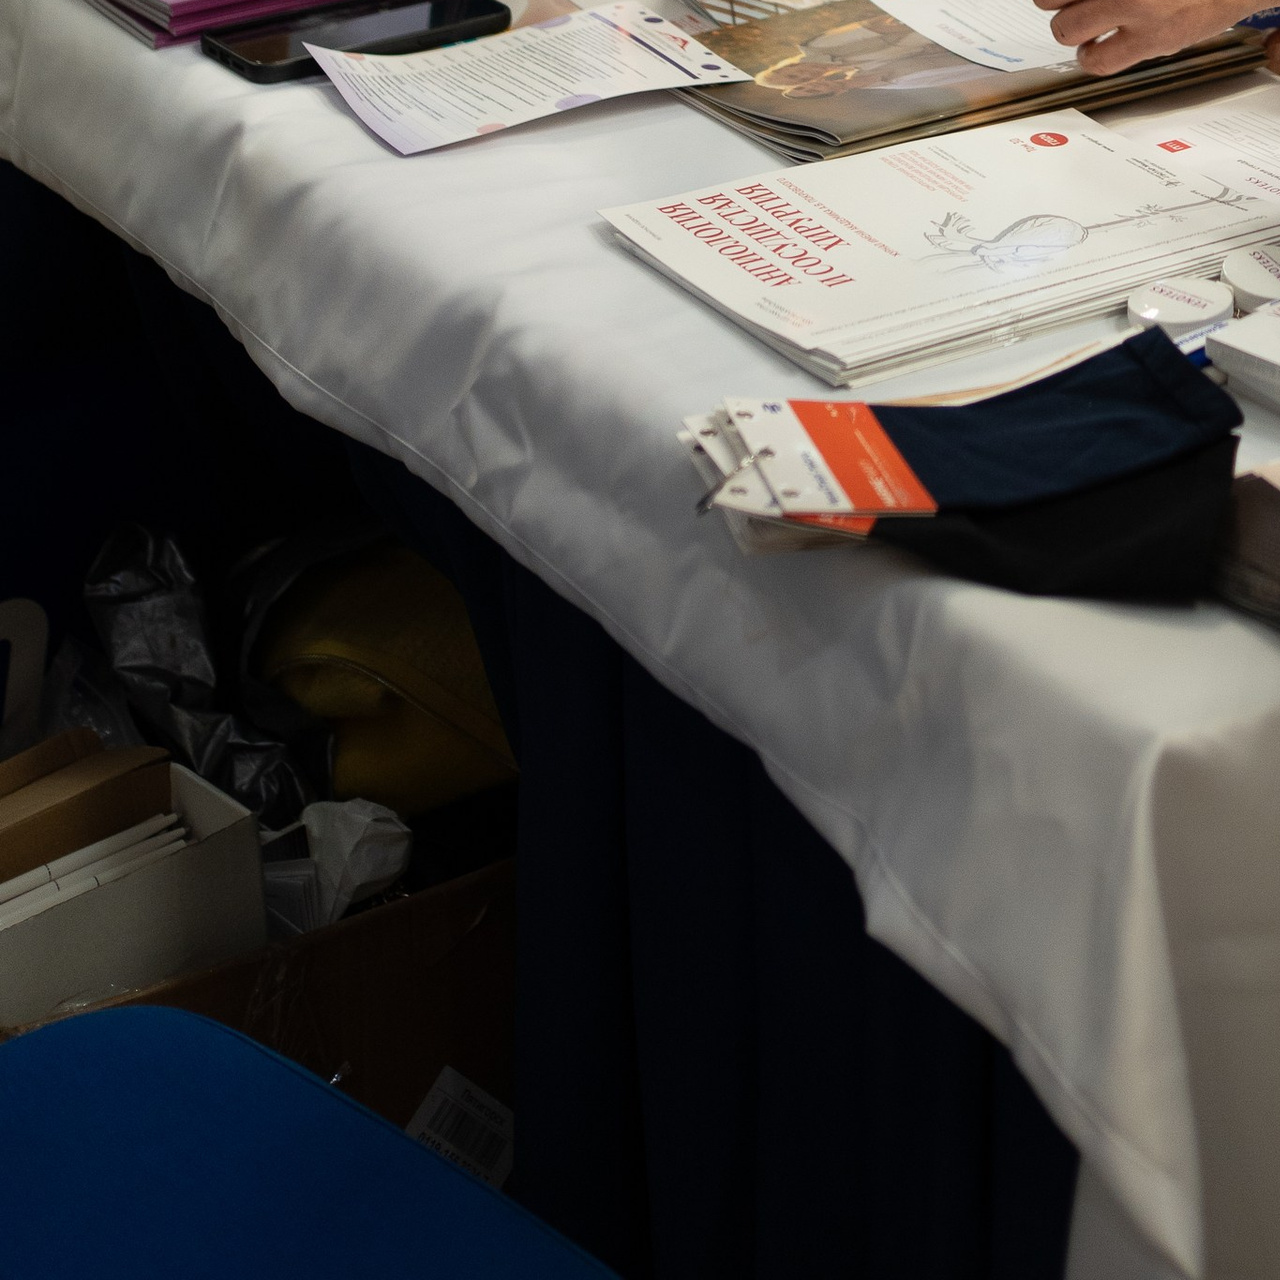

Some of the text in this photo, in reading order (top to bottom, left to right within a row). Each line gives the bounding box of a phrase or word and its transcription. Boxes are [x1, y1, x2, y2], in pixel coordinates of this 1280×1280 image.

[654, 200, 803, 289] АНГИОЛОГИЯ
[694, 191, 837, 278] СОСУДИСТАЯ
[733, 181, 852, 252] ХИРУРГИЯ
[818, 272, 856, 288] И
[1150, 284, 1208, 309] VENOTEKS
